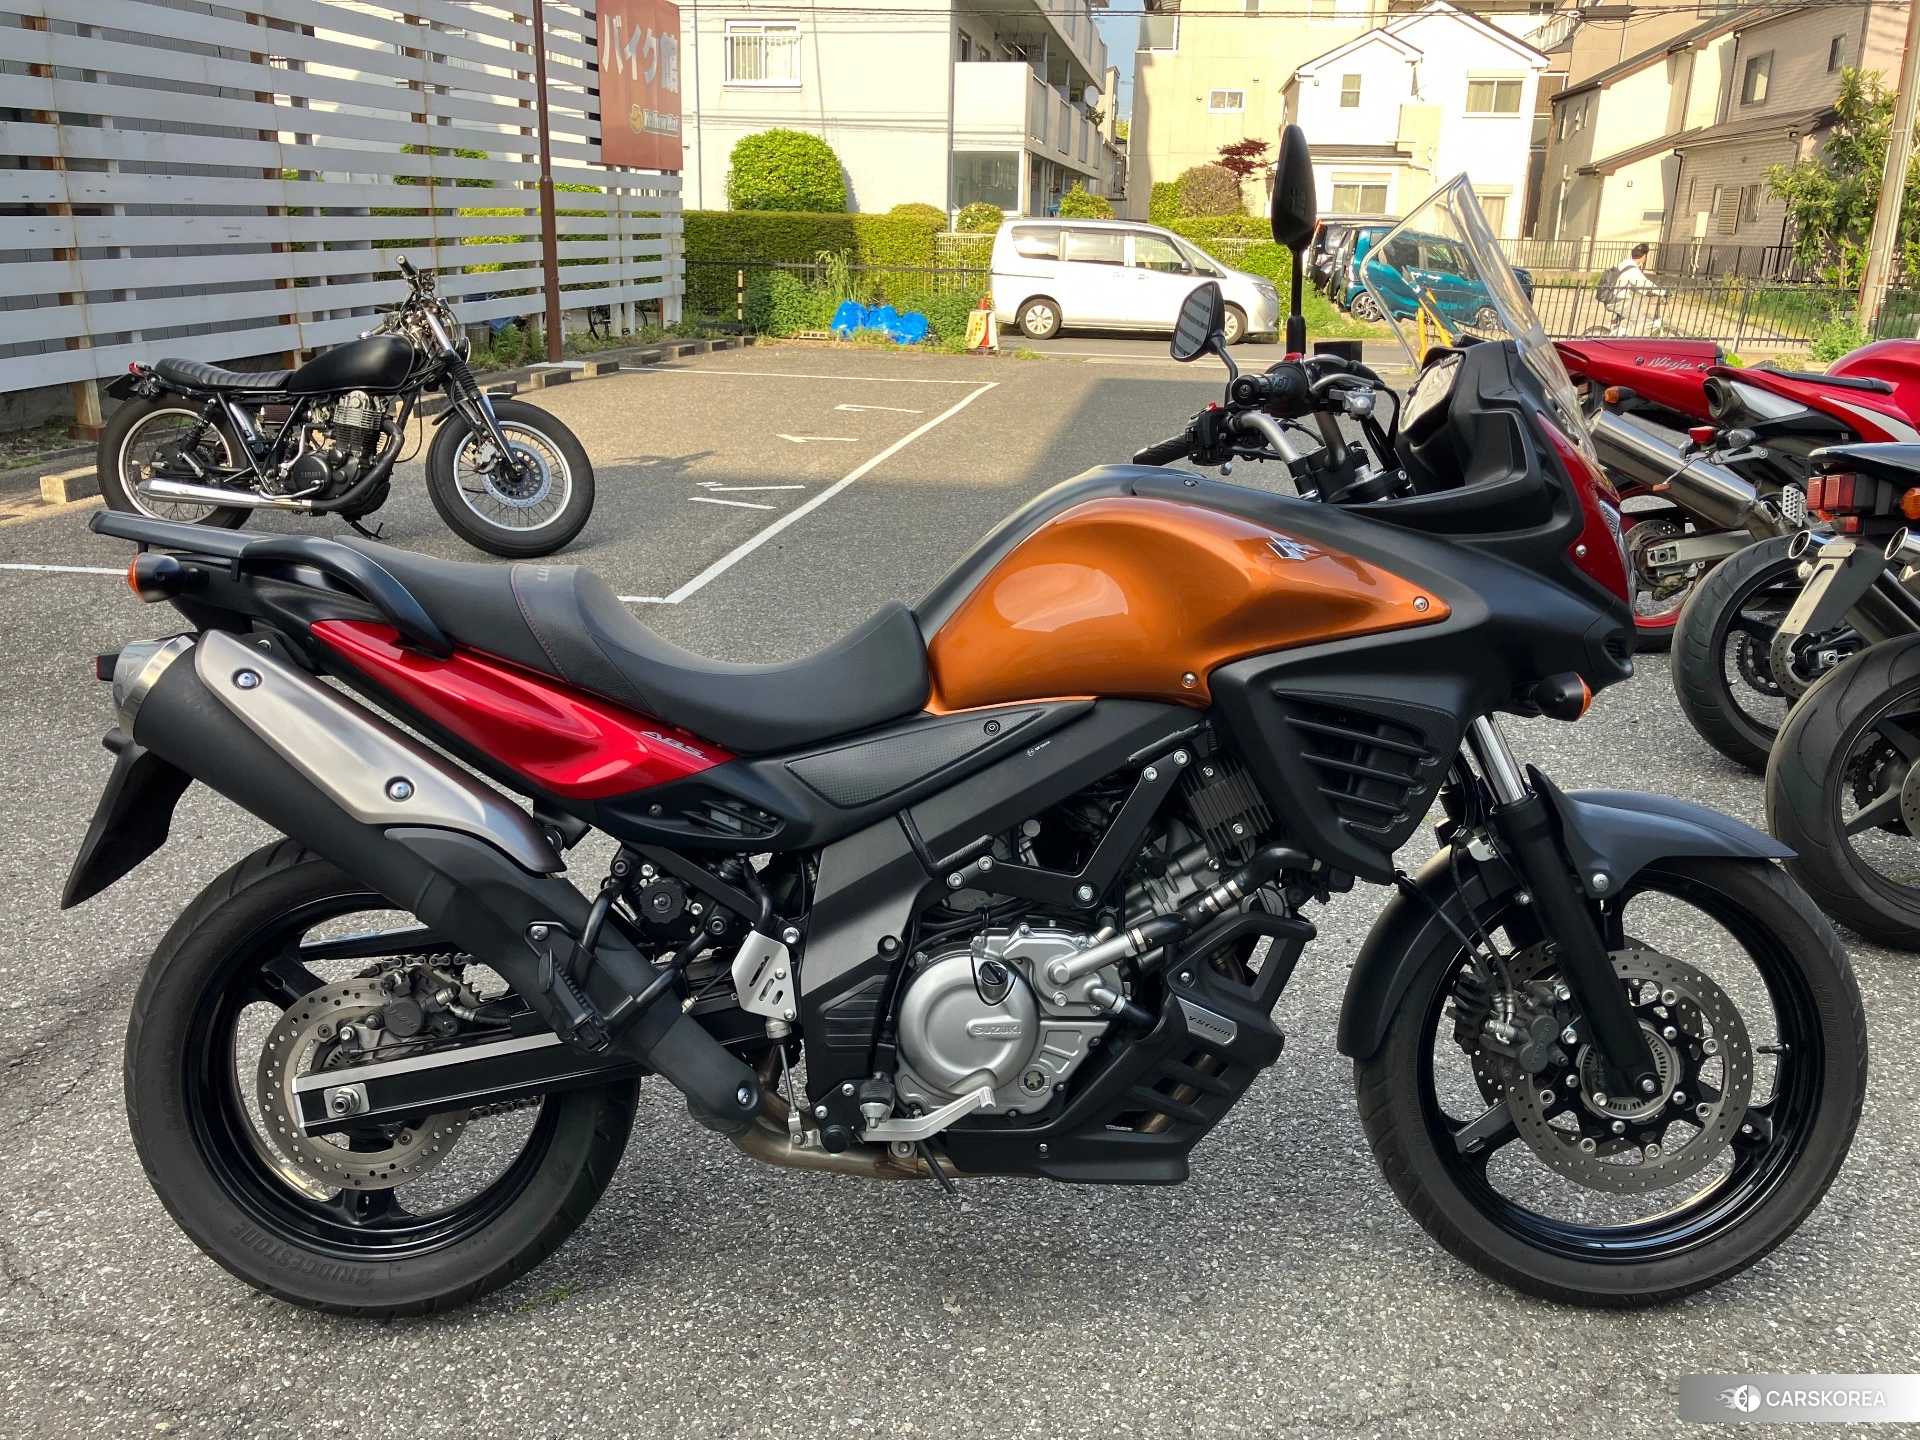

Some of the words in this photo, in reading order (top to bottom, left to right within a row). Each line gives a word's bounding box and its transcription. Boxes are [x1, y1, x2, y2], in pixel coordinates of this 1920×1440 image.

[1647, 356, 1694, 372] Ninja
[640, 730, 706, 759] ABS
[974, 1025, 1022, 1035] SUZUKI
[228, 1220, 379, 1288] BRIDGESTONE
